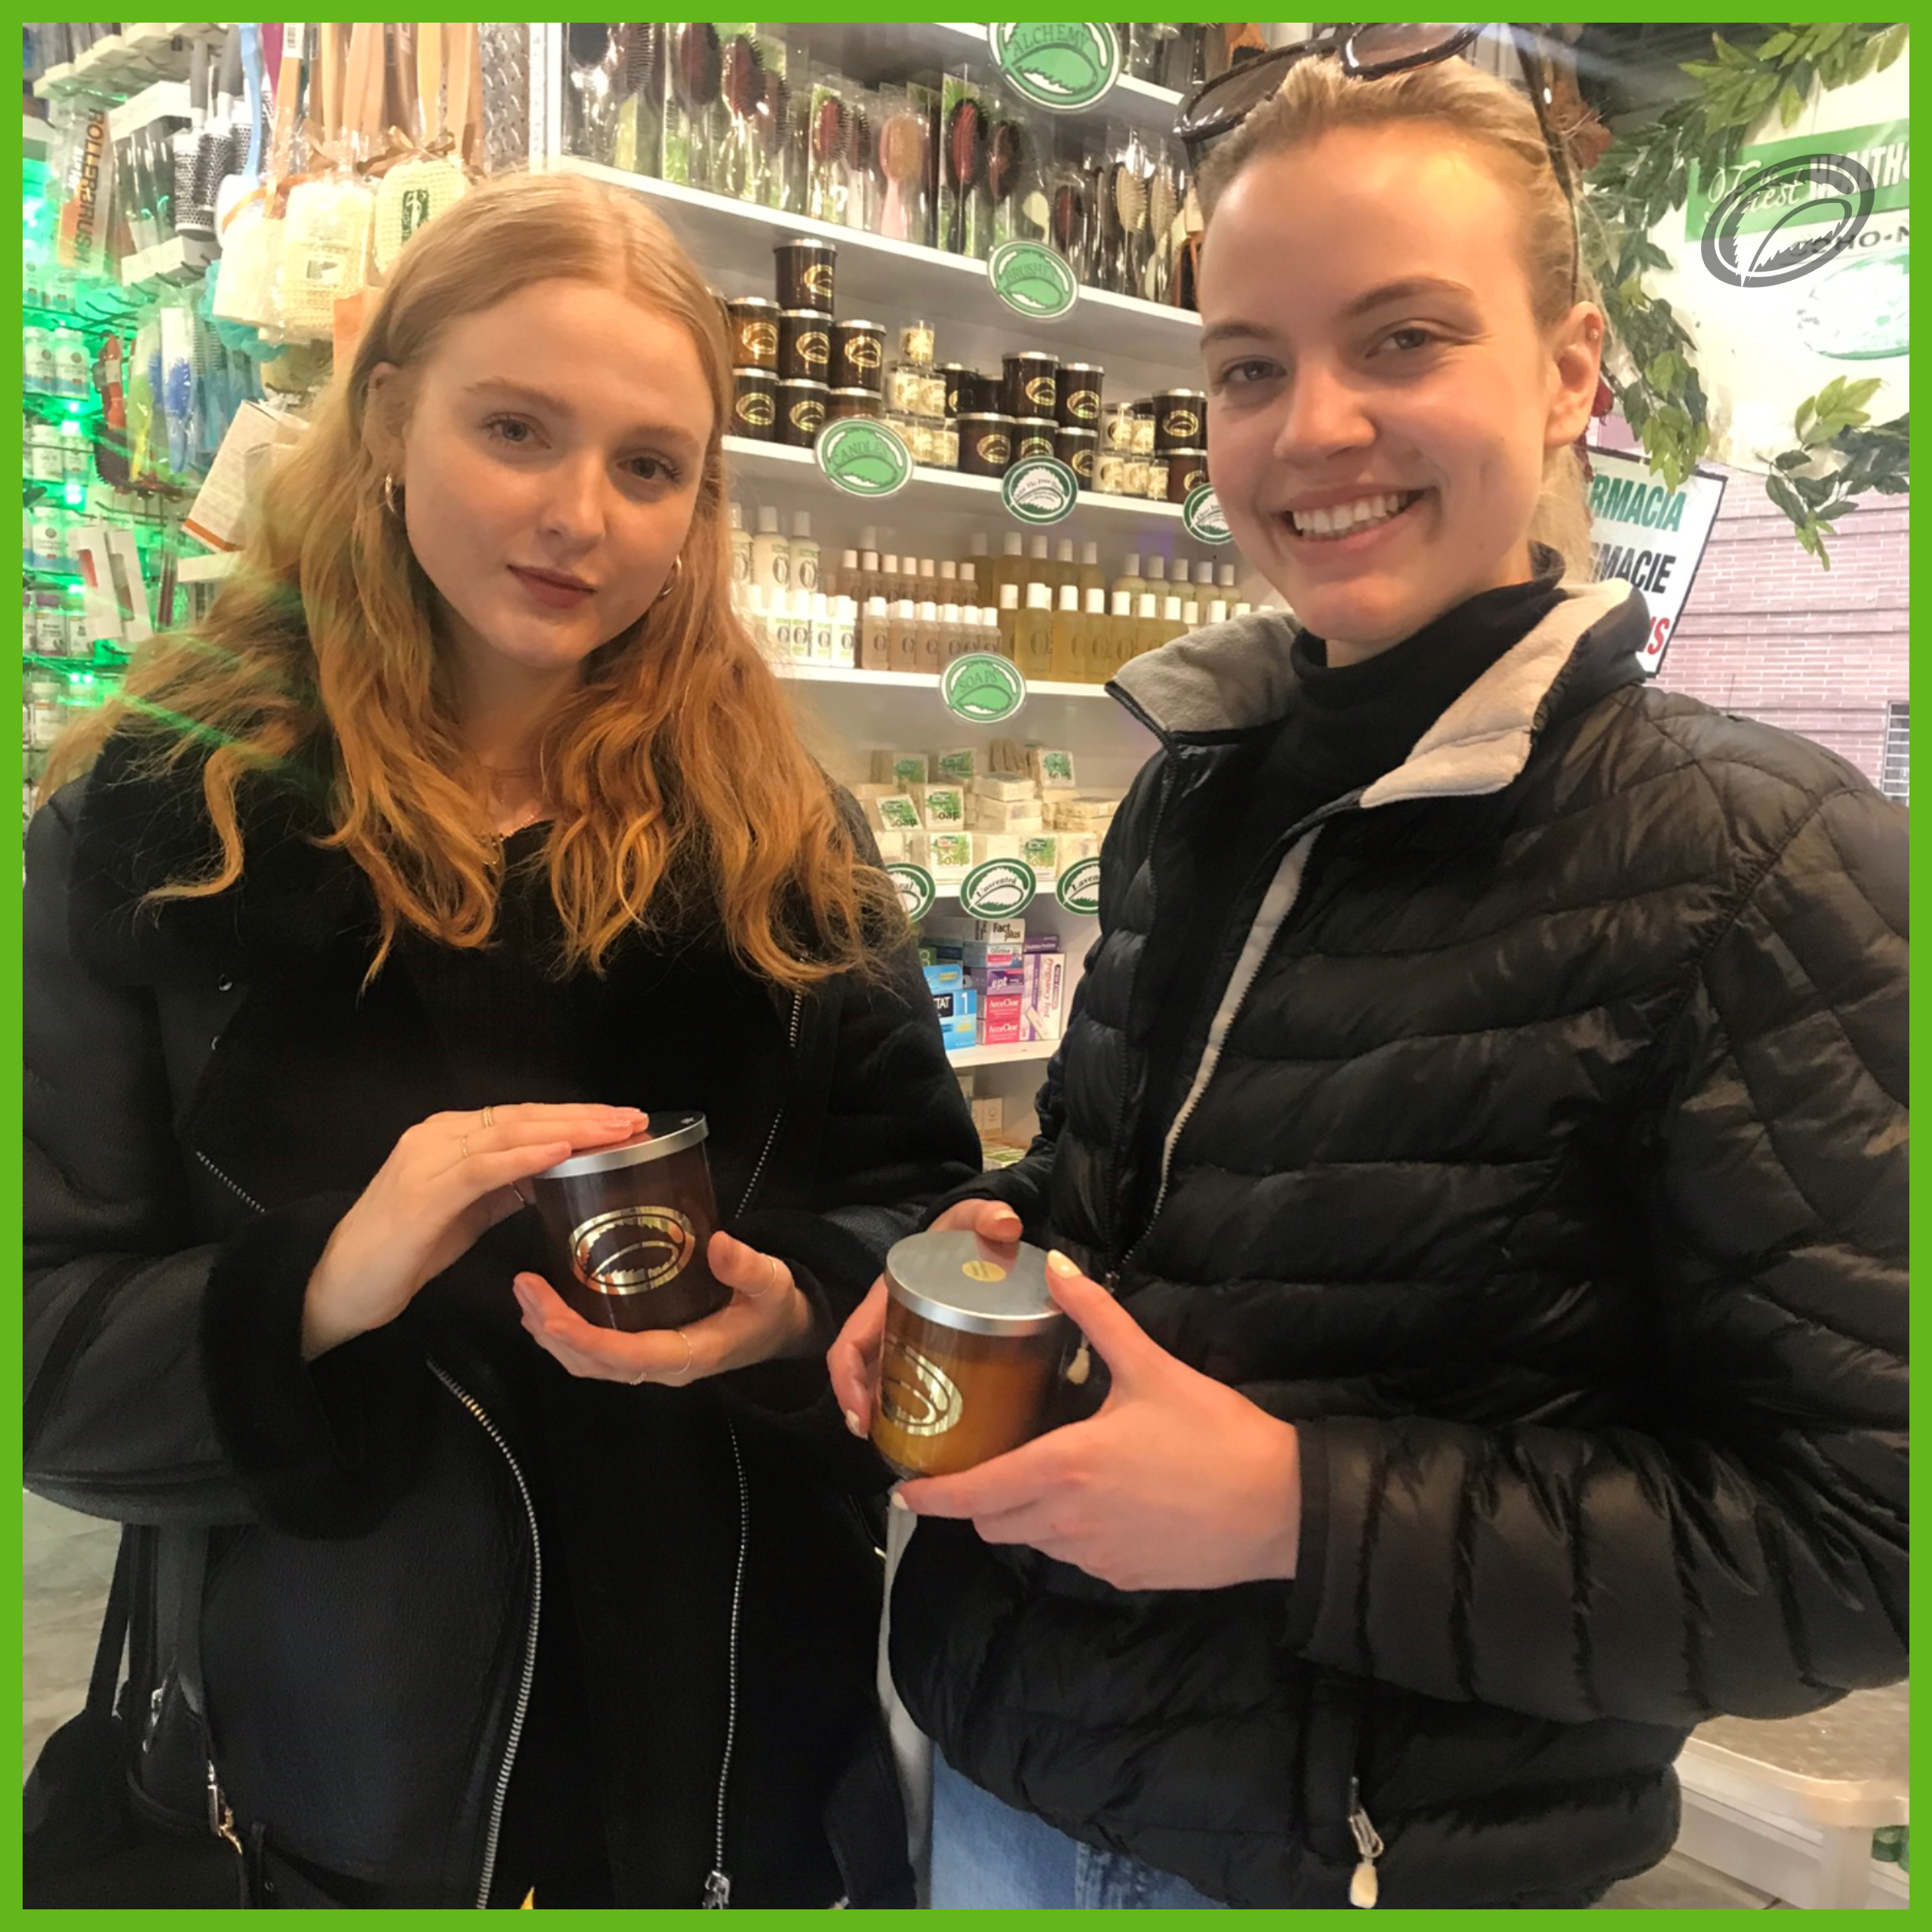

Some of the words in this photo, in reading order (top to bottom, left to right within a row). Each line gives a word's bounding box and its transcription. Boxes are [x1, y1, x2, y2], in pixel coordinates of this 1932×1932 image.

[1013, 23, 1088, 57] ALCHEMY
[74, 108, 106, 264] ROLLERBRUSH
[833, 441, 888, 466] CANDLES
[958, 670, 998, 692] SOAPS
[975, 877, 1017, 898] Unscented
[992, 922, 1011, 934] Fact
[1004, 929, 1021, 941] plus
[991, 977, 1008, 990] ept
[1043, 958, 1054, 999] Pregnancy
[961, 992, 968, 1015] 1
[989, 998, 1020, 1008] AccuClear
[989, 1023, 1019, 1033] AccuClear
